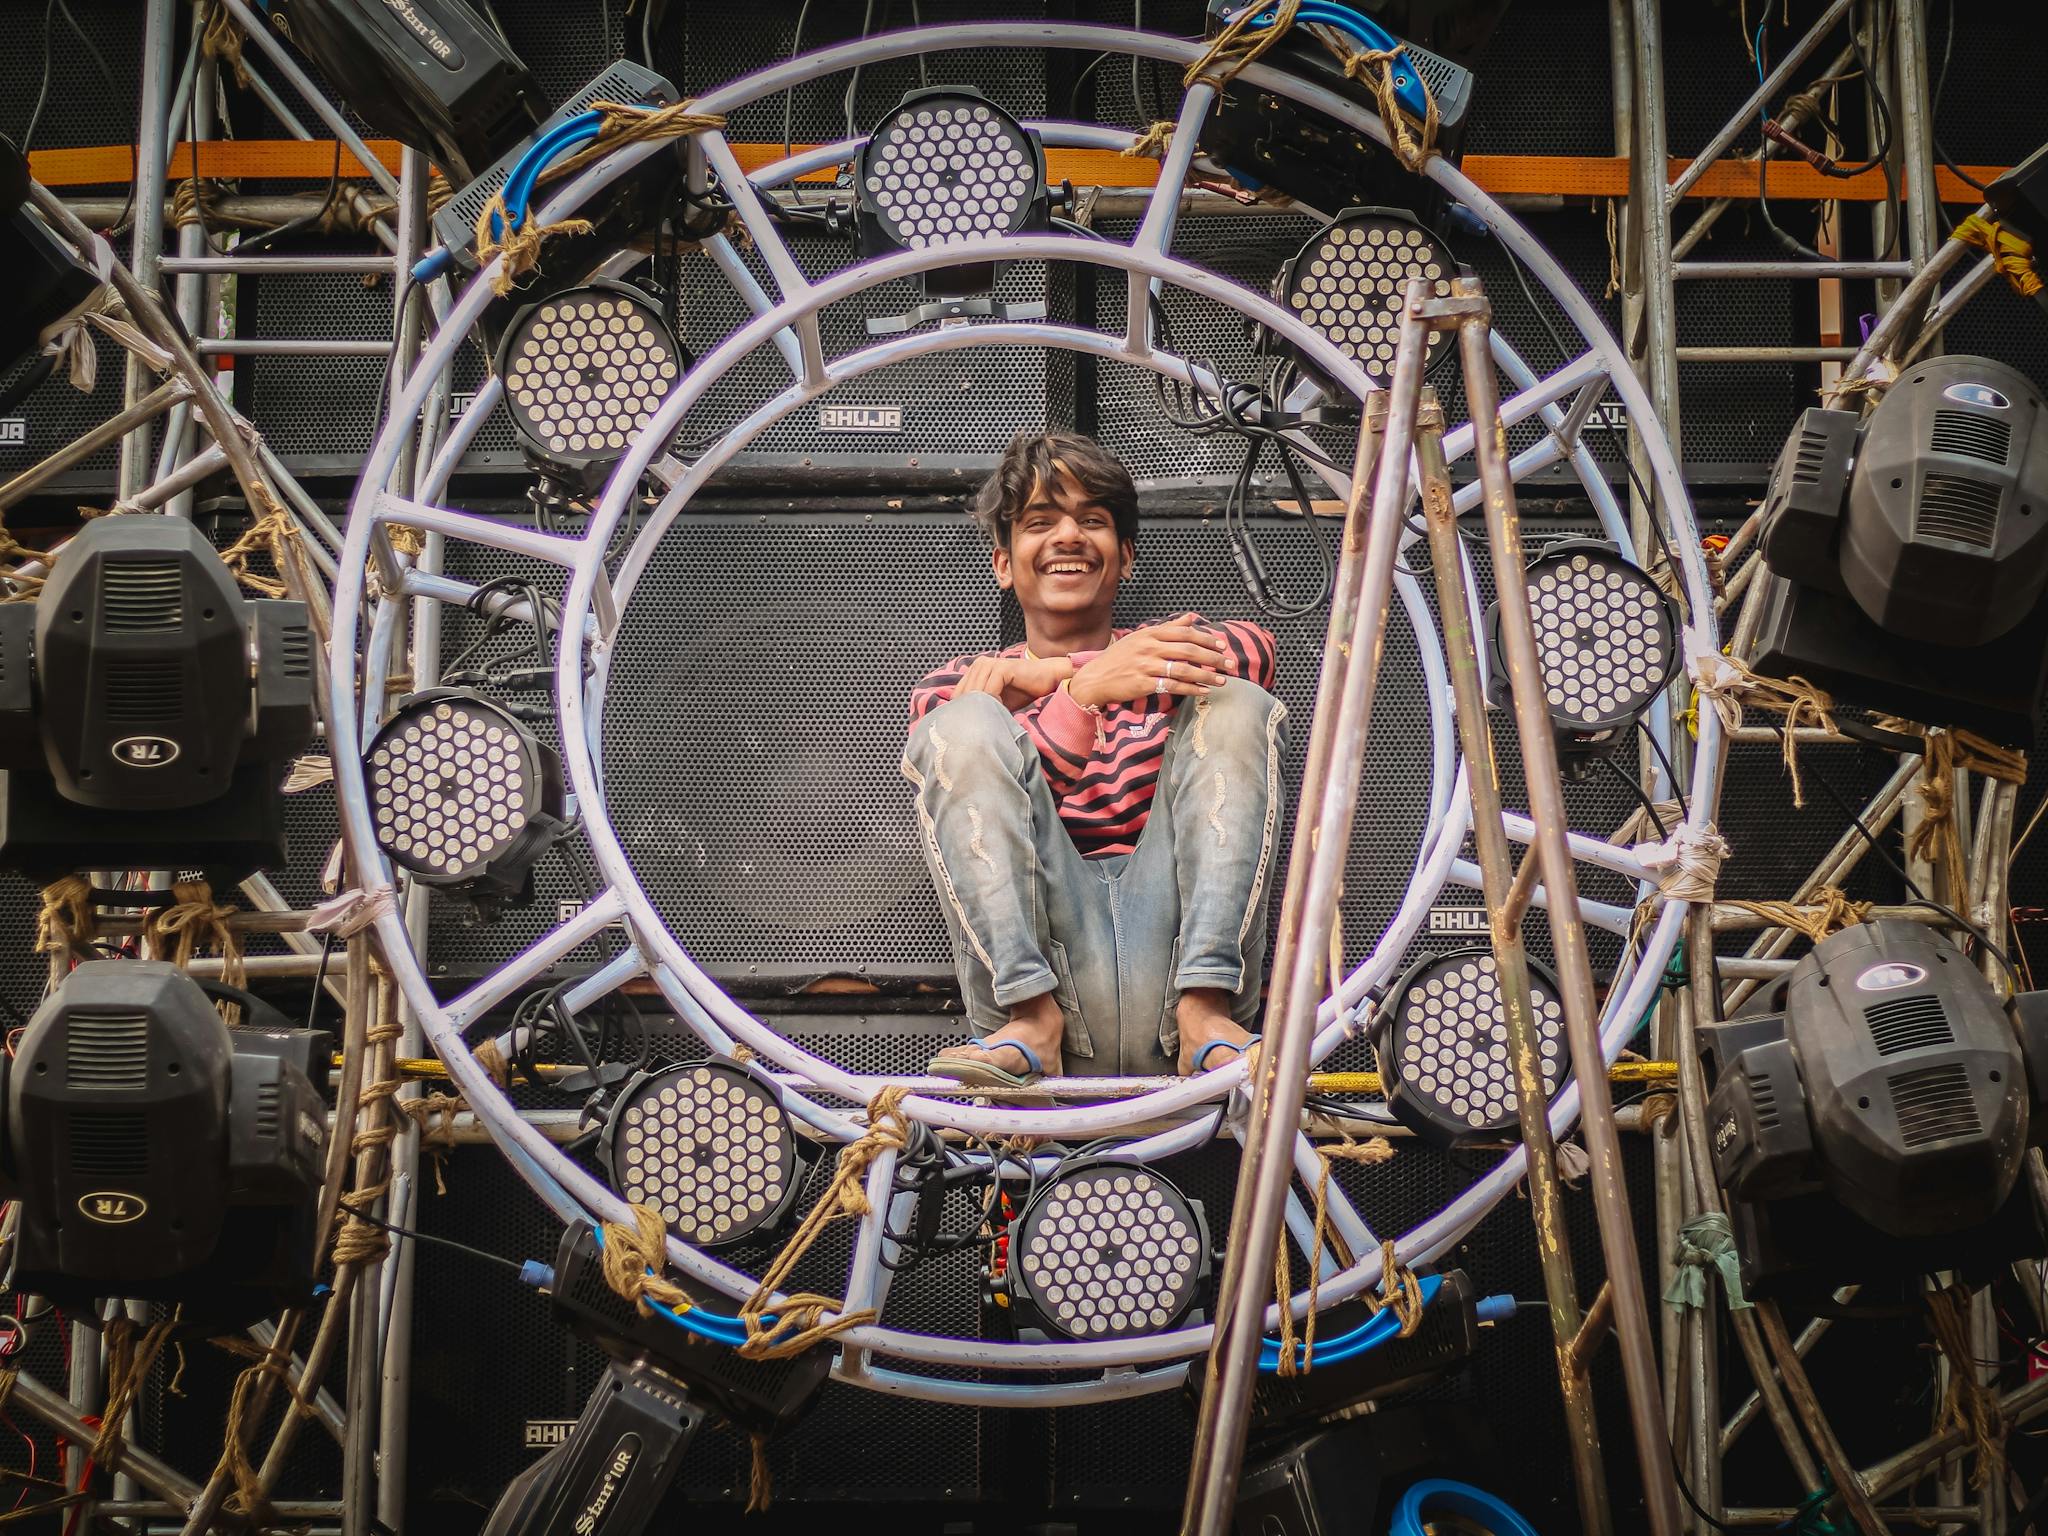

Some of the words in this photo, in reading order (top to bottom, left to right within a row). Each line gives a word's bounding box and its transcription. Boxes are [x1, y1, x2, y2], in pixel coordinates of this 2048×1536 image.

[820, 410, 901, 427] AHUJA
[131, 744, 161, 759] 7R
[1429, 912, 1490, 930] AHU
[96, 1199, 127, 1216] 7R
[526, 1425, 576, 1443] AHU
[610, 1451, 631, 1479] 10R
